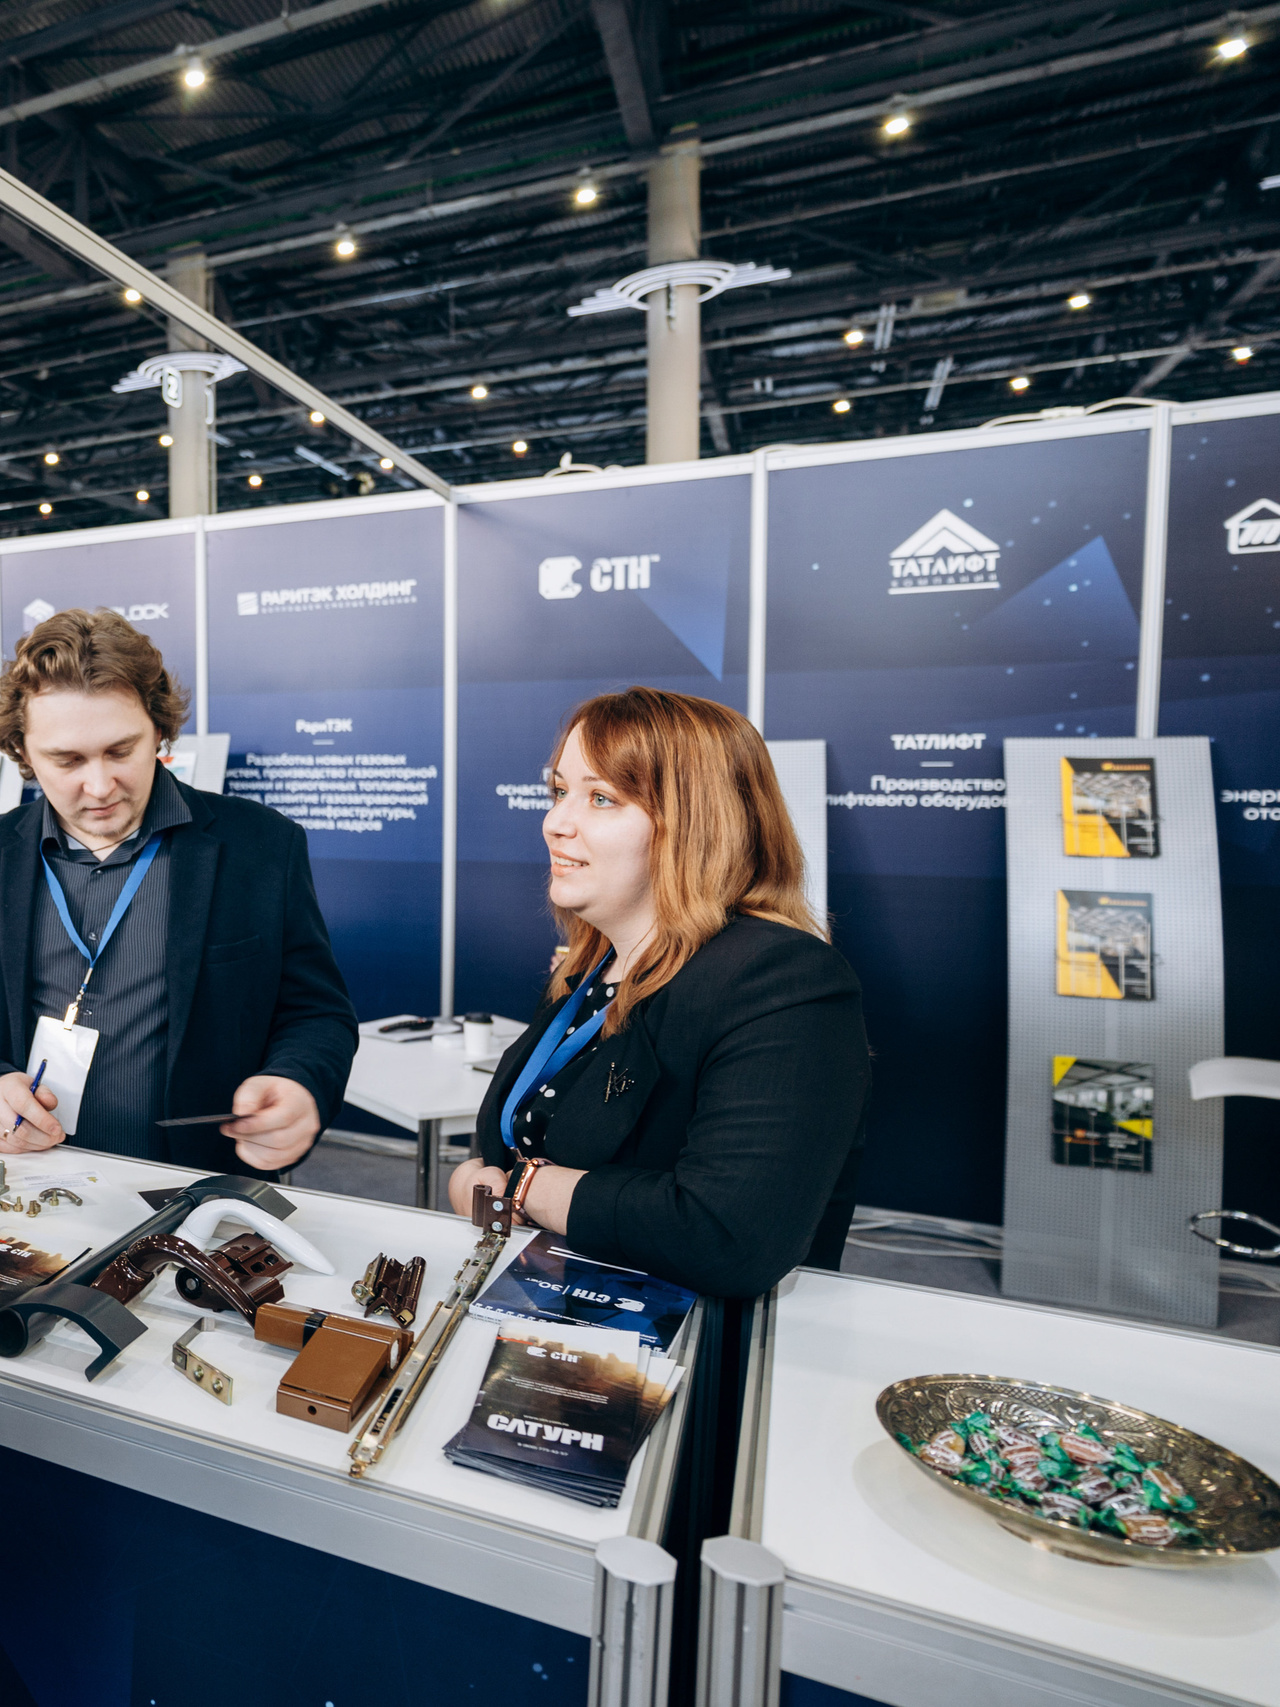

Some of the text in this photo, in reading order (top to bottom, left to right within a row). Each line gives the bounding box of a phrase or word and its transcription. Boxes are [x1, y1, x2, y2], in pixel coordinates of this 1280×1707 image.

[889, 552, 1001, 578] ТАТЛИФТ
[261, 579, 417, 606] РАРИТЭК ХОЛДИНГ
[295, 718, 353, 735] РариТЭК
[891, 733, 986, 750] ТАТЛИФТ
[246, 752, 407, 766] Разработка новых газовых
[263, 768, 347, 780] производство
[358, 780, 427, 791] топливных
[871, 775, 1006, 794] Производство
